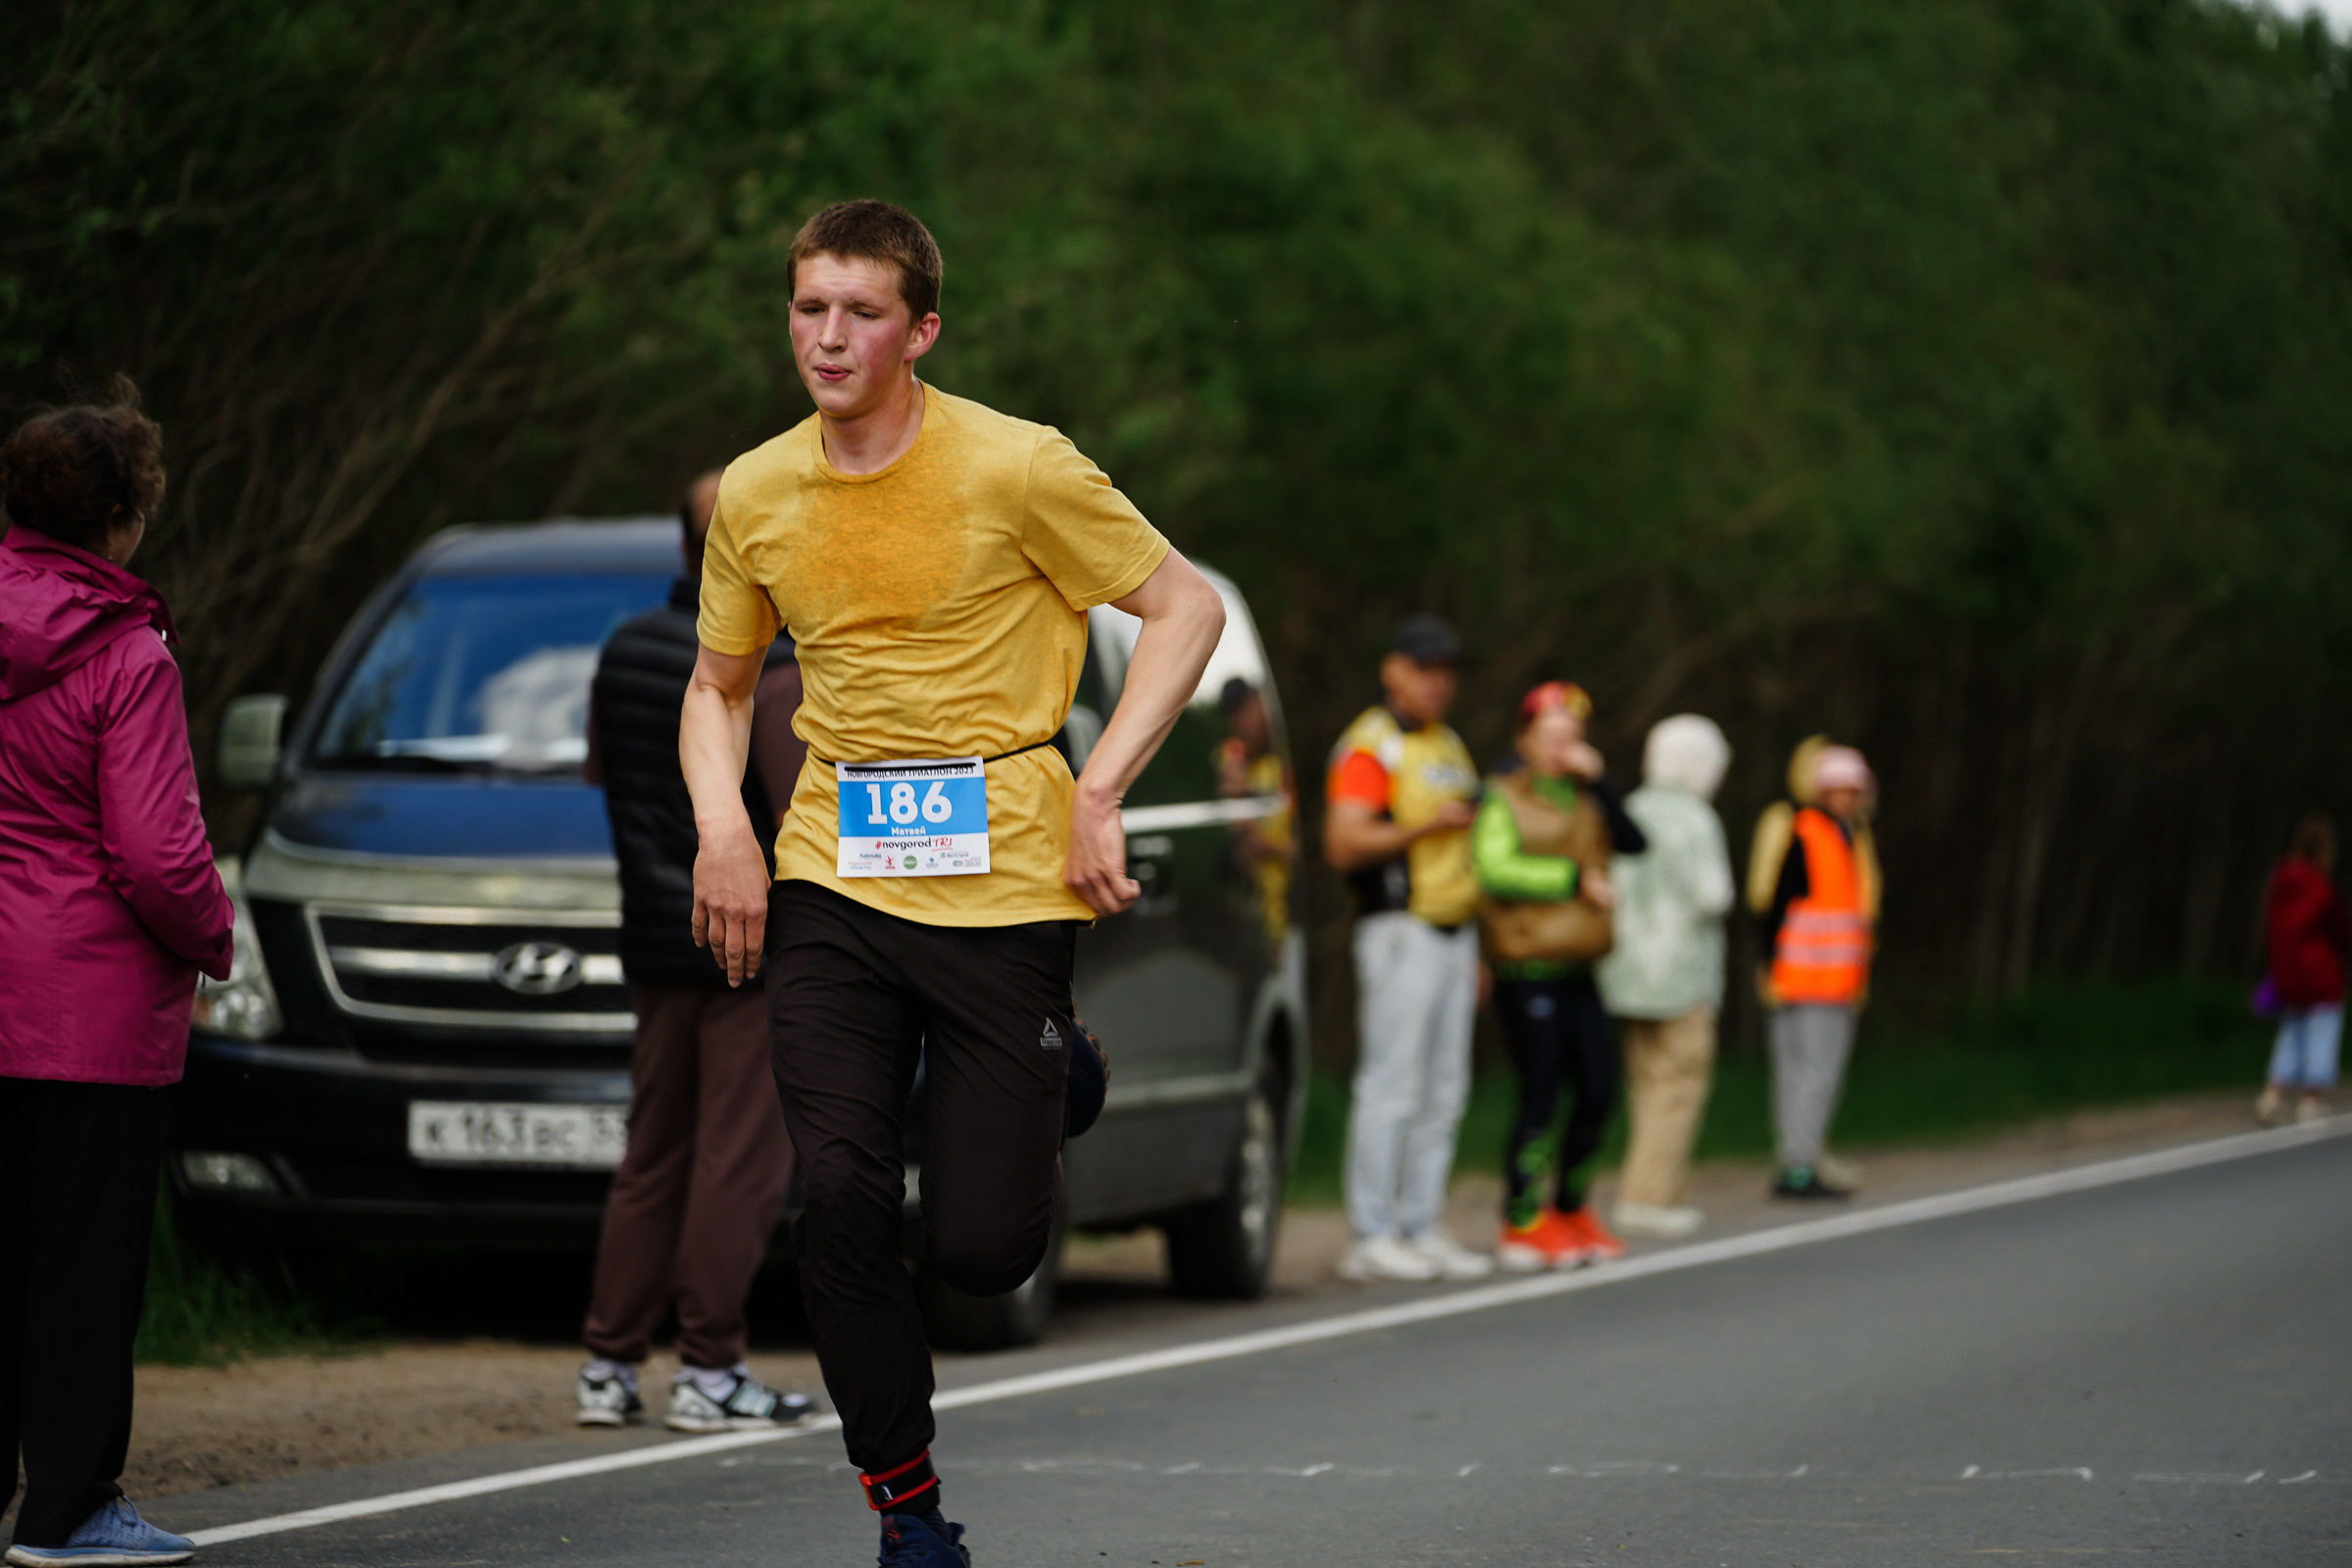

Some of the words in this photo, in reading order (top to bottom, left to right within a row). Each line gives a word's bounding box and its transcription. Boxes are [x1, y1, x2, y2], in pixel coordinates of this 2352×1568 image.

[955, 764, 975, 775] 2023
[866, 781, 953, 825] 186
[891, 825, 927, 836] Матвей
